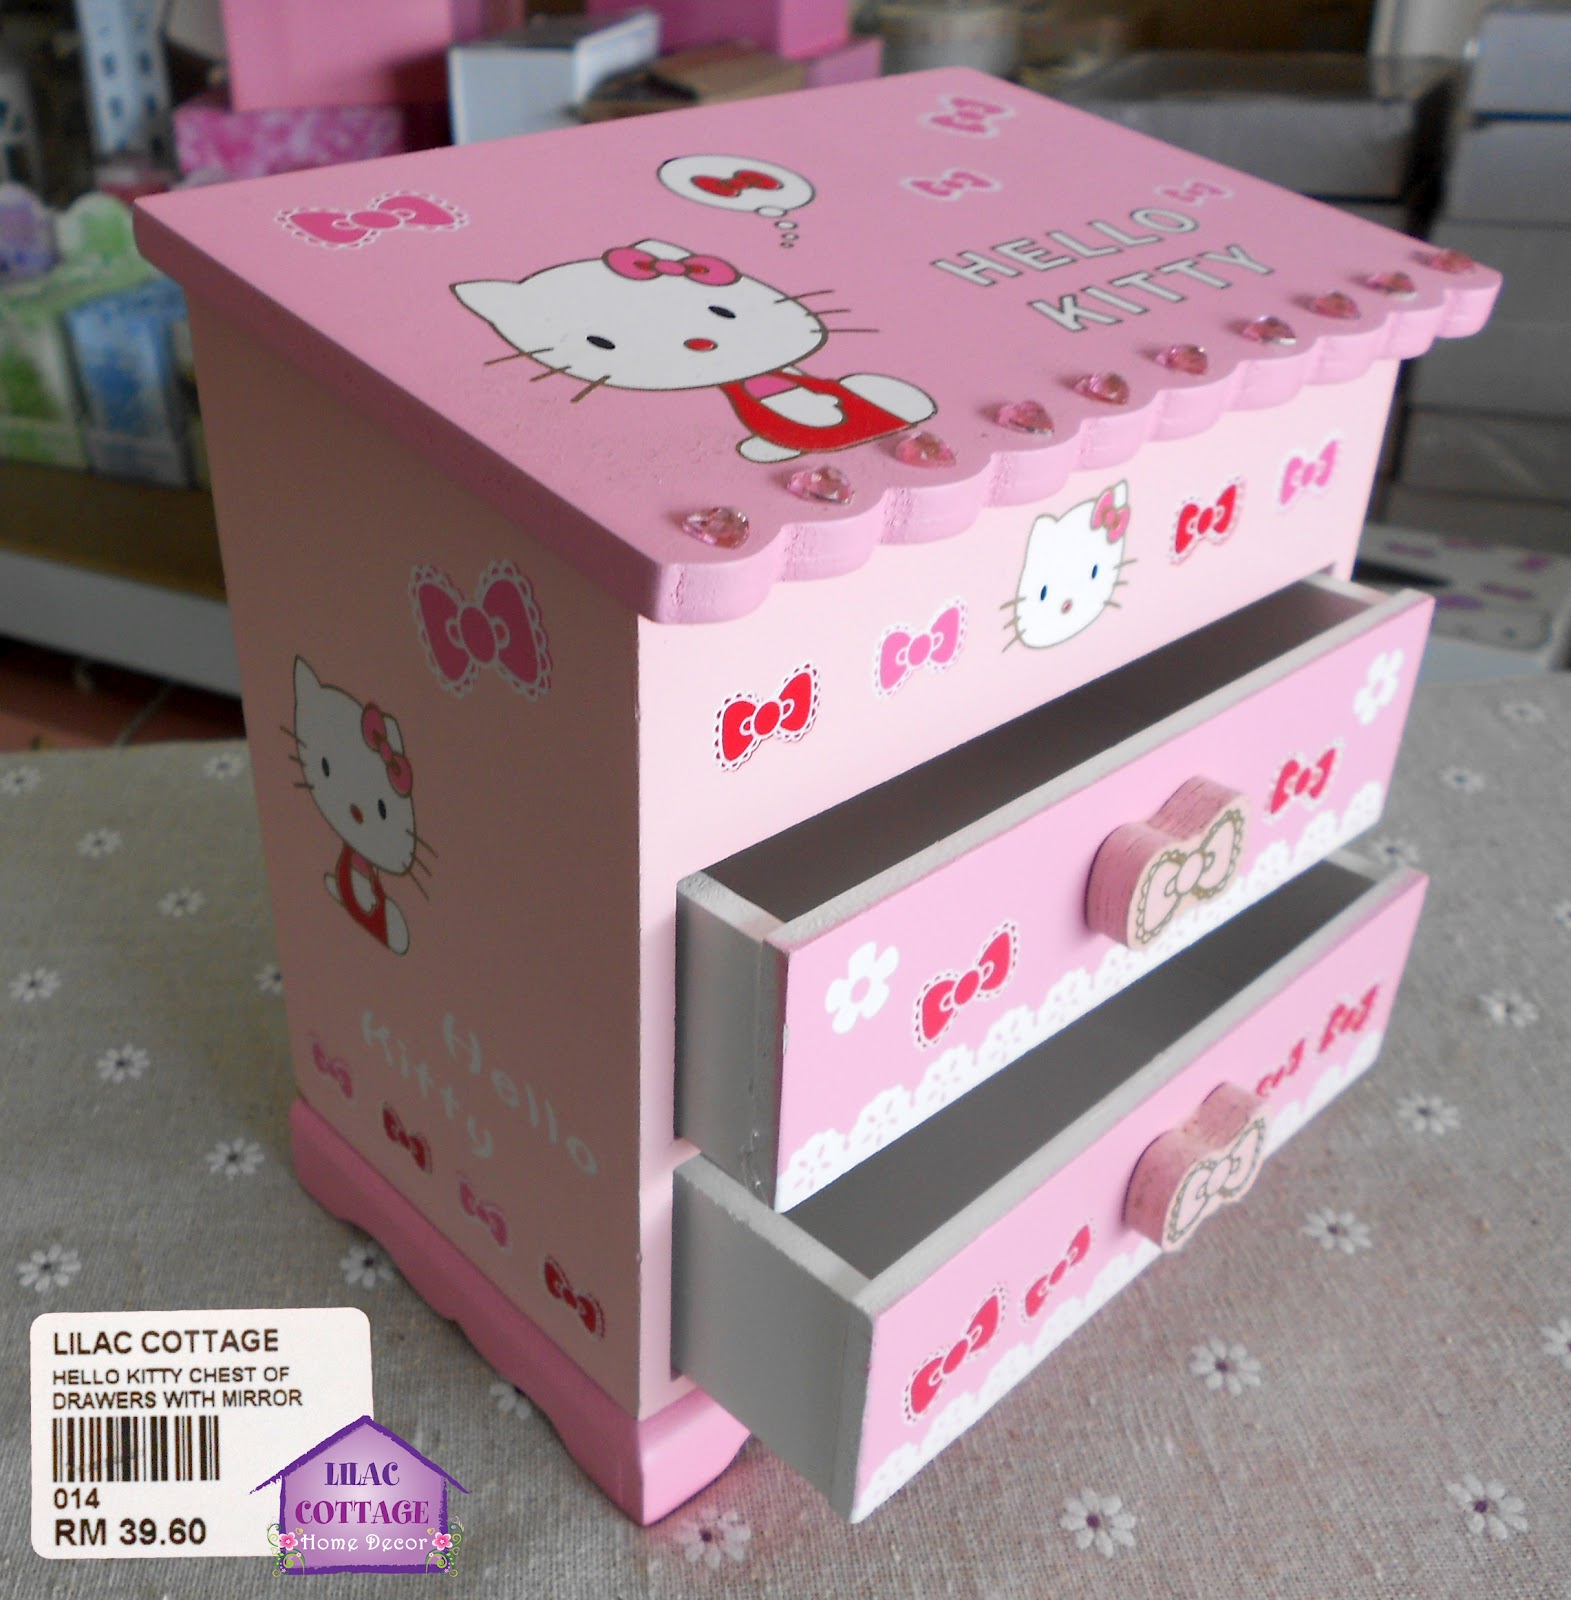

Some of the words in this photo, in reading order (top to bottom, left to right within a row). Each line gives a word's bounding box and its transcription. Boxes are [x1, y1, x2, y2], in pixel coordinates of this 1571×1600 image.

[930, 207, 1200, 287] HELLO
[1027, 244, 1274, 332] KITTY
[53, 1331, 132, 1355] LILAC
[141, 1329, 279, 1354] COTTAGE
[53, 1369, 119, 1385] HELLO
[127, 1368, 183, 1384] KITTY
[189, 1367, 256, 1383] CHEST
[263, 1366, 290, 1382] OF
[53, 1392, 156, 1410] DRAWERS
[162, 1391, 215, 1408] WITH
[222, 1389, 303, 1407] MIRROR
[53, 1488, 100, 1510] 014
[54, 1519, 107, 1546] RM
[119, 1517, 206, 1545] 39.60
